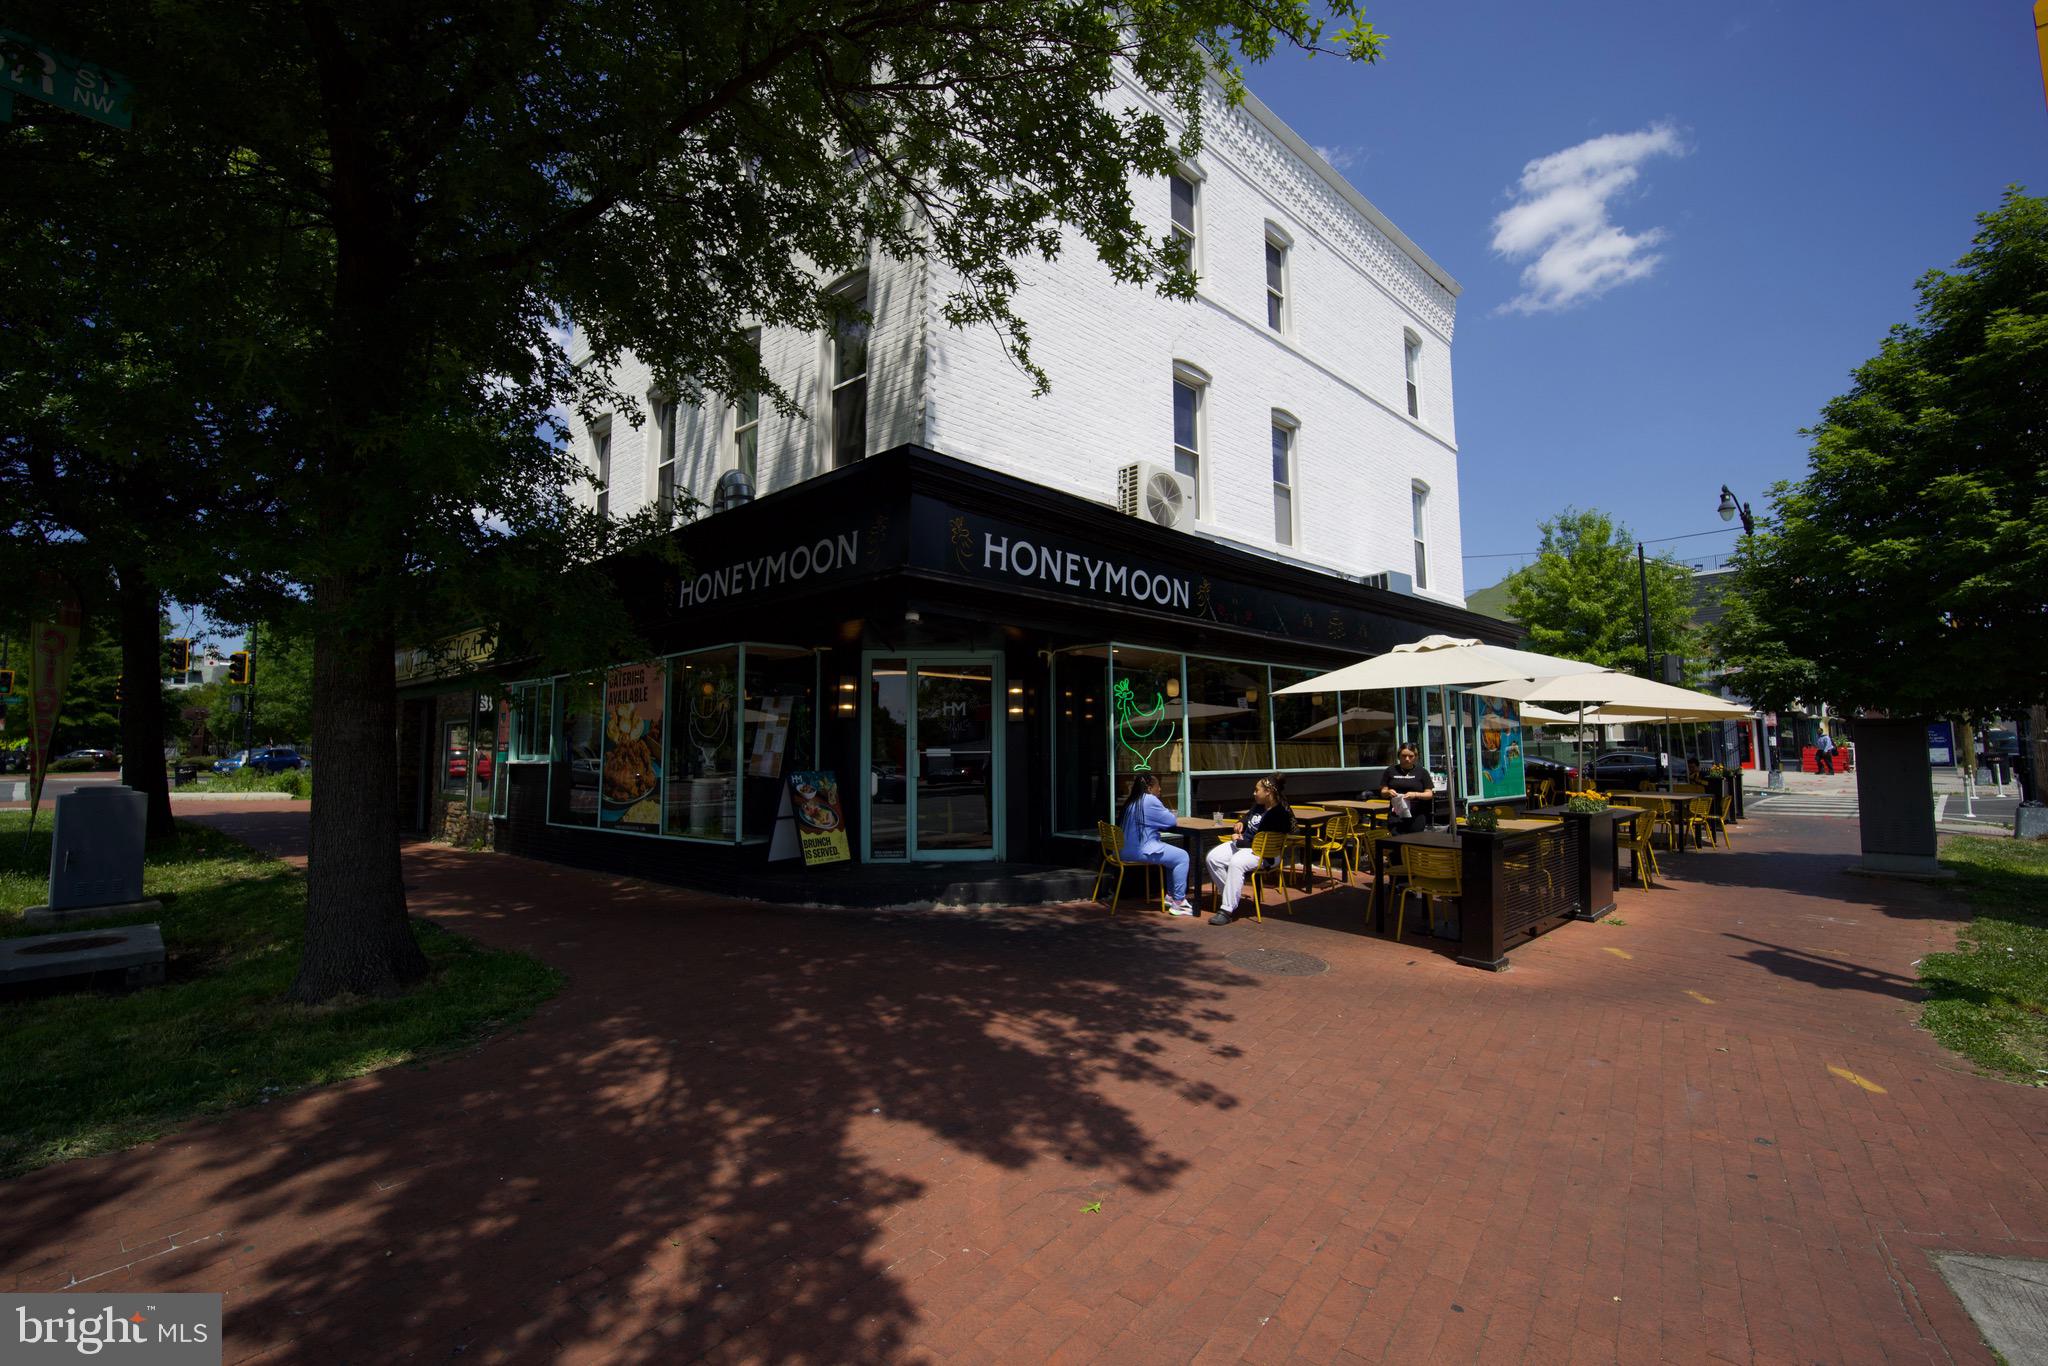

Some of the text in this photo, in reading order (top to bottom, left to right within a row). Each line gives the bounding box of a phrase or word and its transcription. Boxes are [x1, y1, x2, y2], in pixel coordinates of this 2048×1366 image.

[73, 86, 115, 114] NW
[678, 530, 858, 609] HONEYMOON
[984, 532, 1190, 609] HONEYMOON
[608, 669, 644, 689] CATERING
[608, 686, 648, 706] AVAILABLE
[943, 702, 967, 716] HM
[791, 775, 803, 784] HM
[803, 837, 831, 849] BRUNCH
[805, 849, 812, 859] IS
